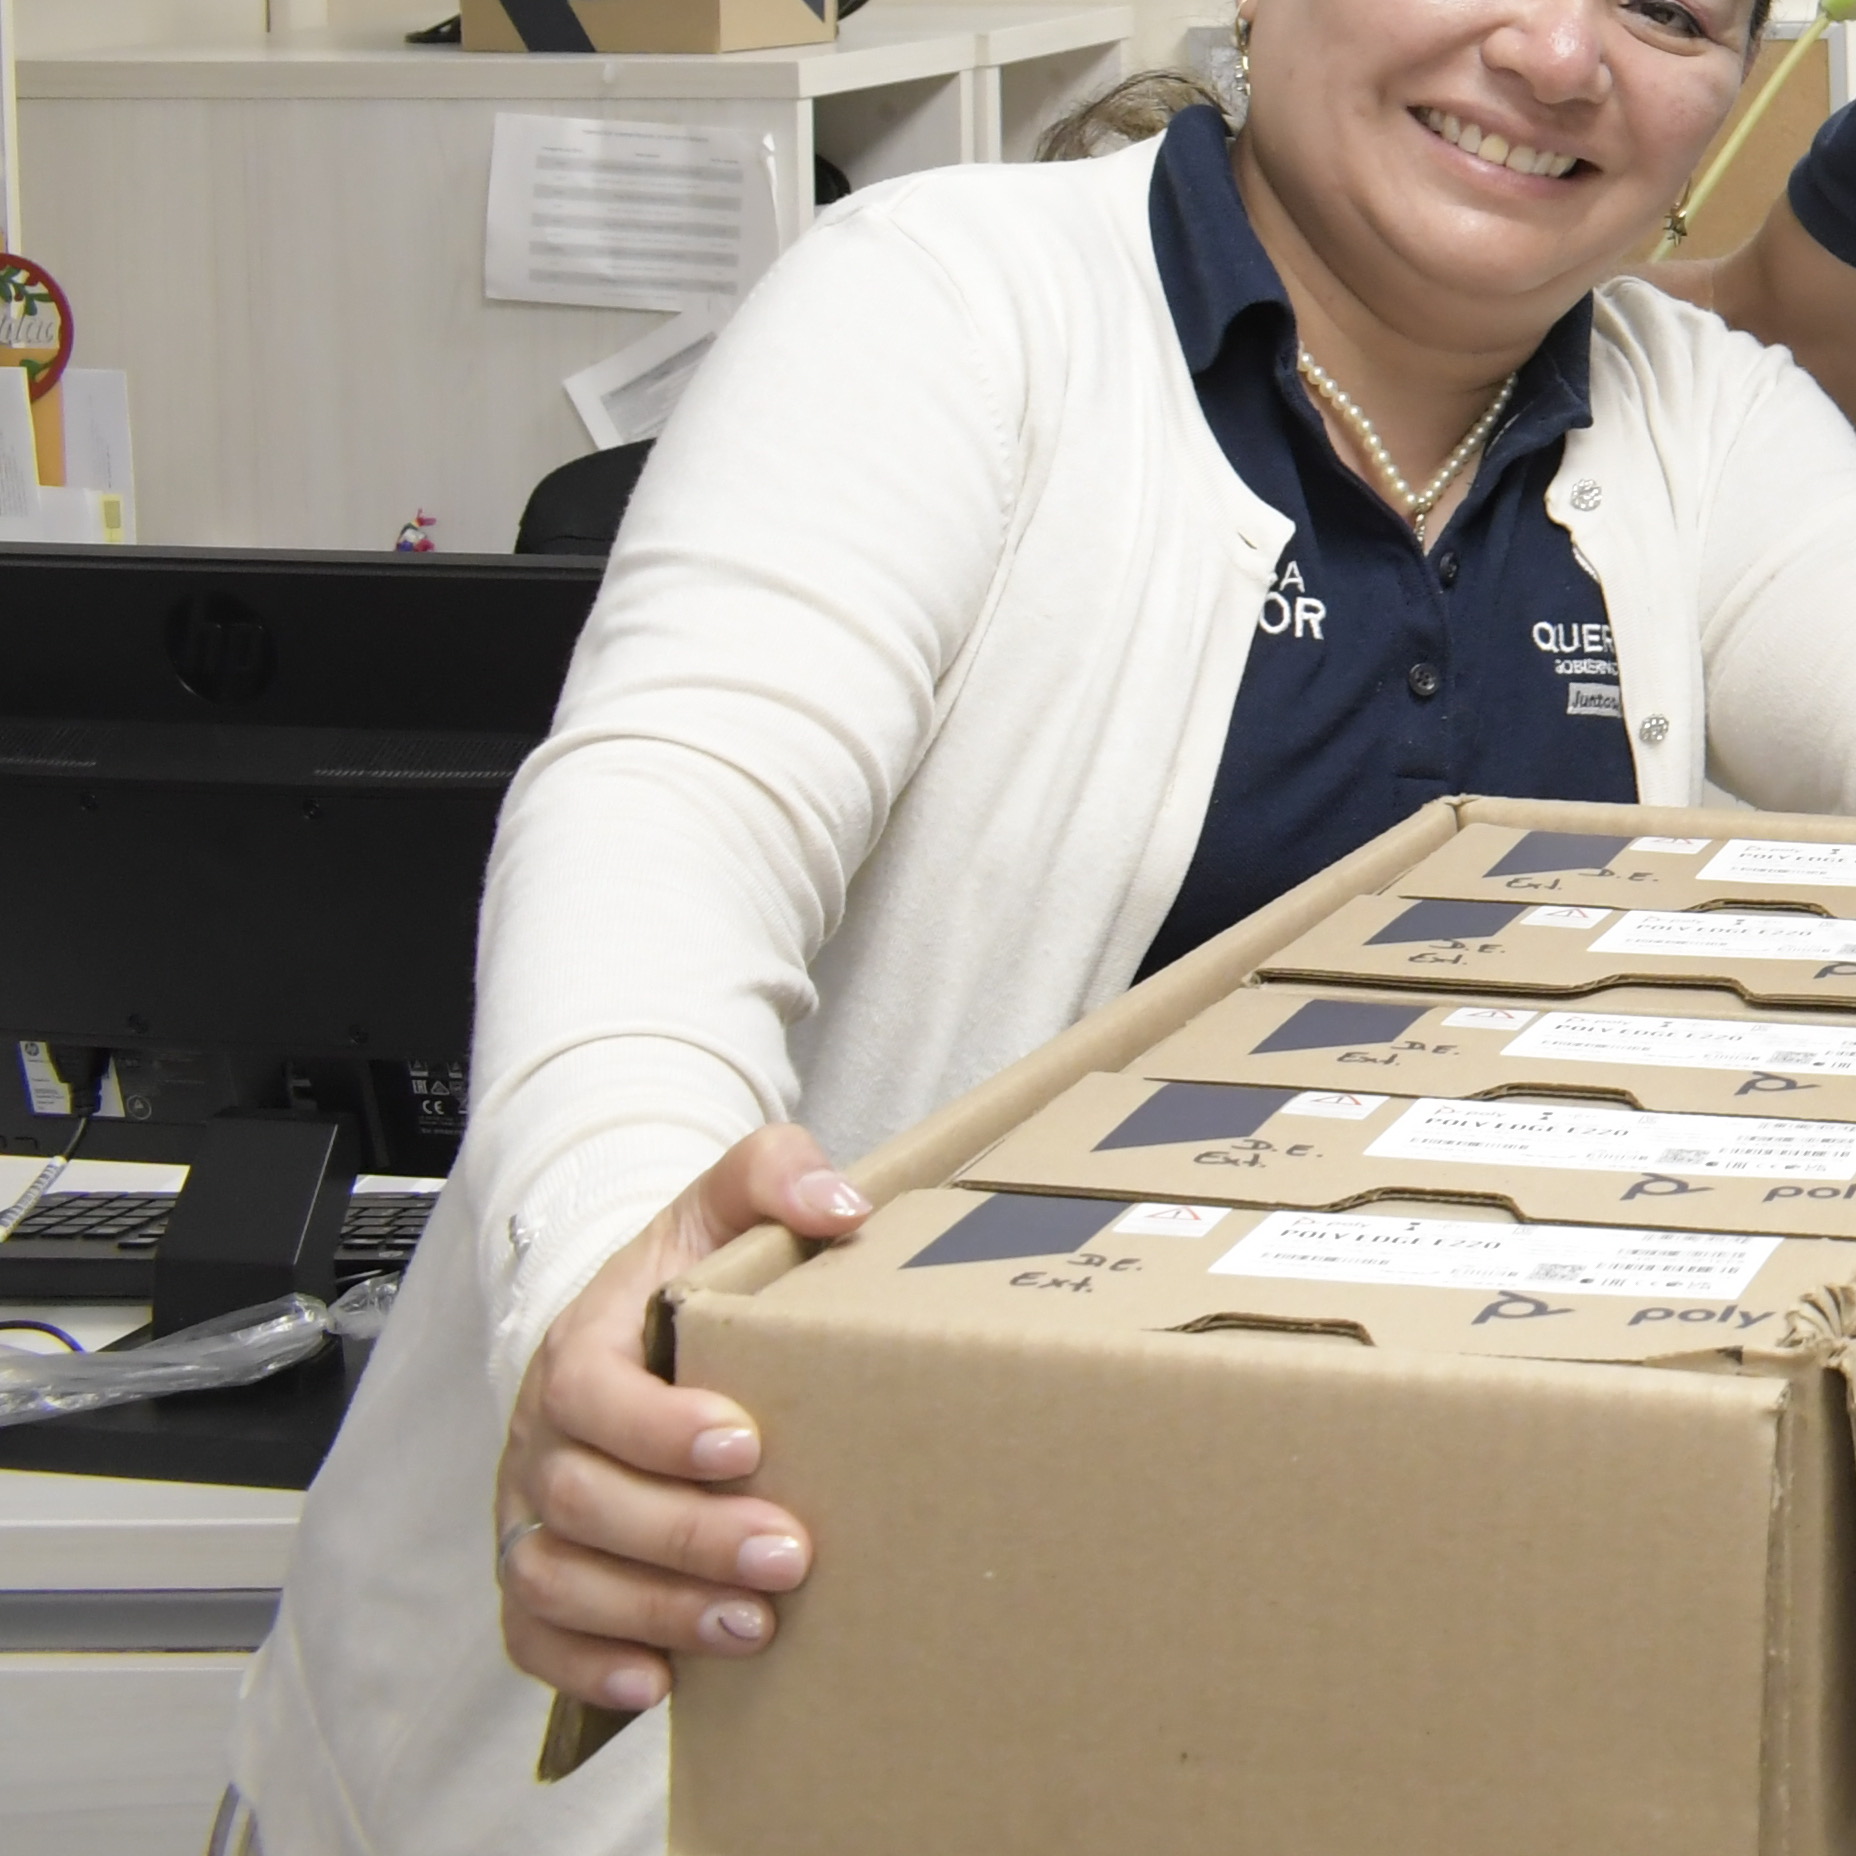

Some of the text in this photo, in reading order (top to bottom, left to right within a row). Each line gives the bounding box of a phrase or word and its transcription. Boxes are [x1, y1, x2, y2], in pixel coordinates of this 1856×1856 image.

[1192, 1149, 1268, 1171] Ext.
[1007, 1269, 1096, 1295] Ext.
[1626, 1303, 1777, 1330] poly
